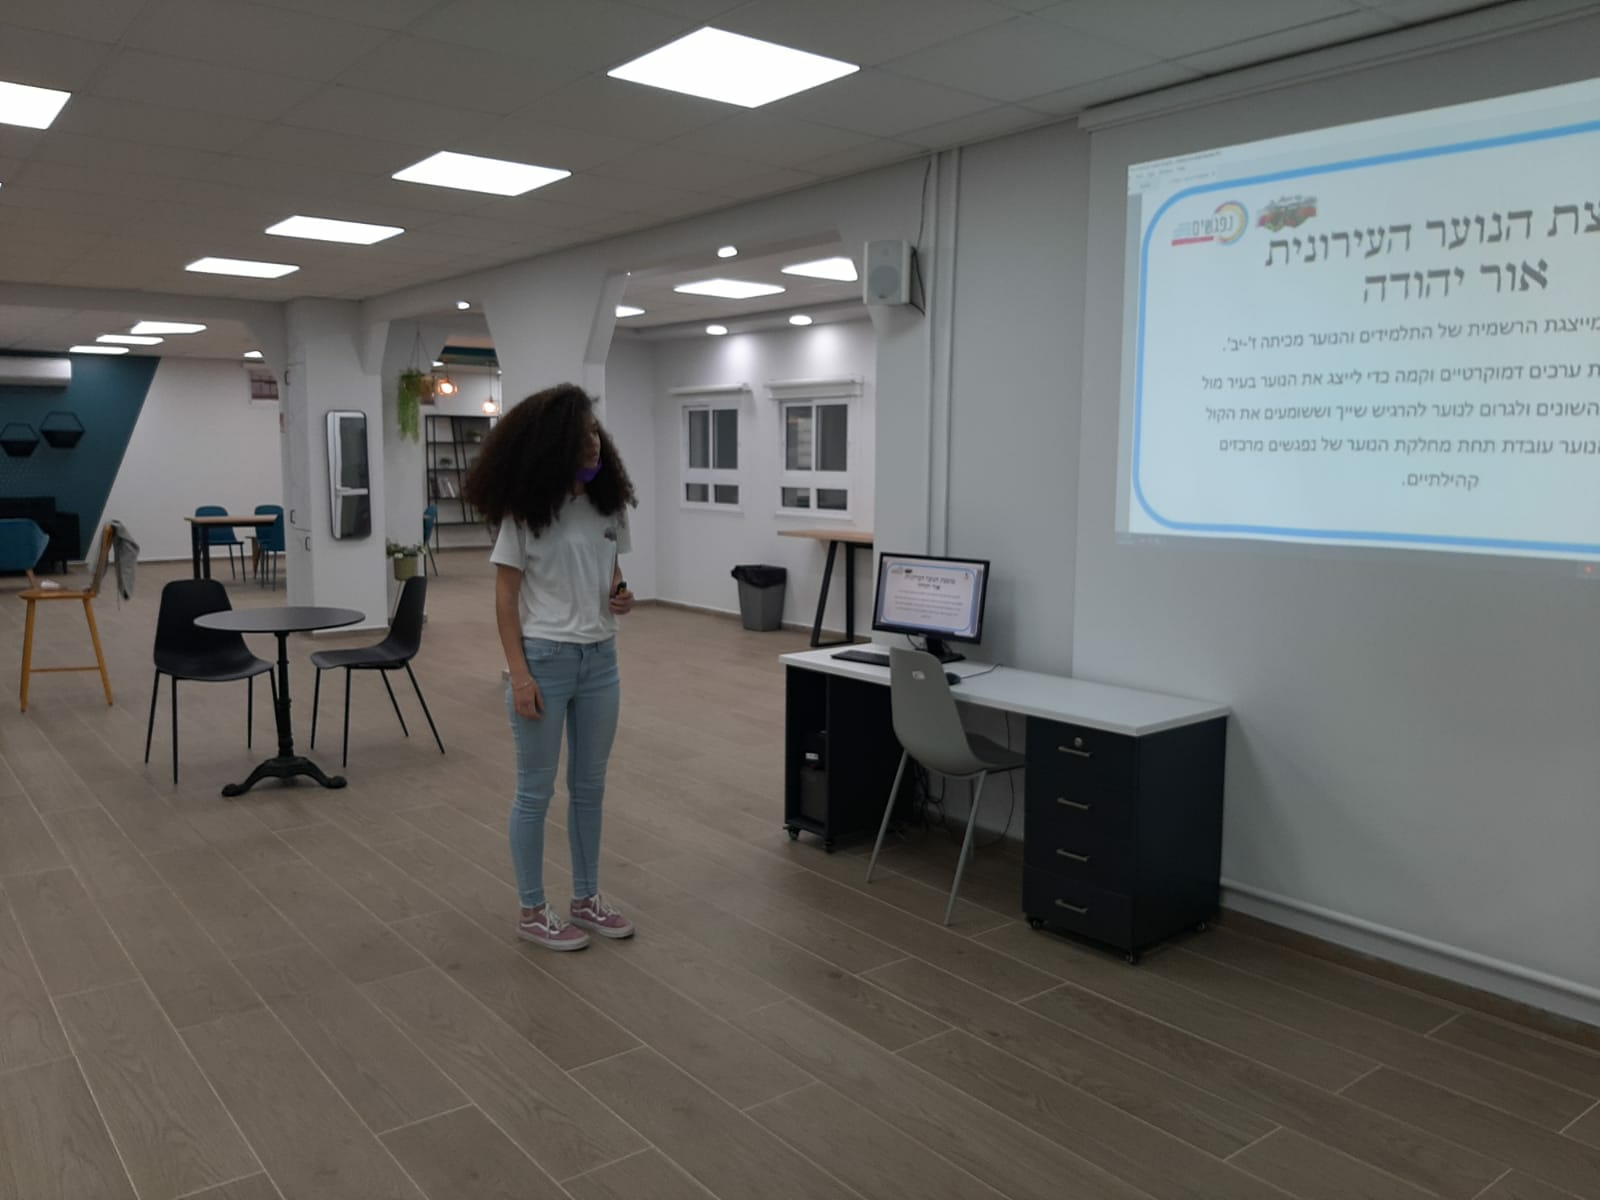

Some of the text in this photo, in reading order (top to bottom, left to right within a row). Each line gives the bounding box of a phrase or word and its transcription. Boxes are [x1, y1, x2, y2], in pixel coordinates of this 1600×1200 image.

[1426, 210, 1533, 250] הנוער
[1265, 224, 1412, 267] העירונית
[1363, 258, 1548, 304] אור יהודה
[1359, 324, 1433, 344] התלמידים
[1438, 322, 1463, 338] של
[1467, 319, 1538, 337] הרשמית
[1260, 334, 1304, 349] מכיתה
[1309, 331, 1355, 346] והנוער
[1327, 369, 1362, 385] לייצג
[1367, 371, 1390, 384] כדי
[1395, 368, 1434, 385] וקמה
[1440, 365, 1524, 384] דמוקרטיים
[1529, 364, 1581, 379] ערכים
[1202, 375, 1223, 390] מול
[1228, 376, 1256, 389] בעיר
[1261, 374, 1297, 388] הנוער
[1302, 373, 1323, 386] את
[1206, 400, 1599, 423] השונים ולגרום לנוער להרגיש שייך וששומעים את הקול
[1219, 438, 1263, 451] מרכזים
[1268, 438, 1317, 452] נפגשים
[1321, 437, 1343, 451] של
[1349, 438, 1389, 451] הנוער
[1394, 436, 1451, 456] מחלקת
[1457, 439, 1495, 453] תחת
[1501, 440, 1554, 454] עובדת
[1402, 472, 1479, 491] קהילתיים.
